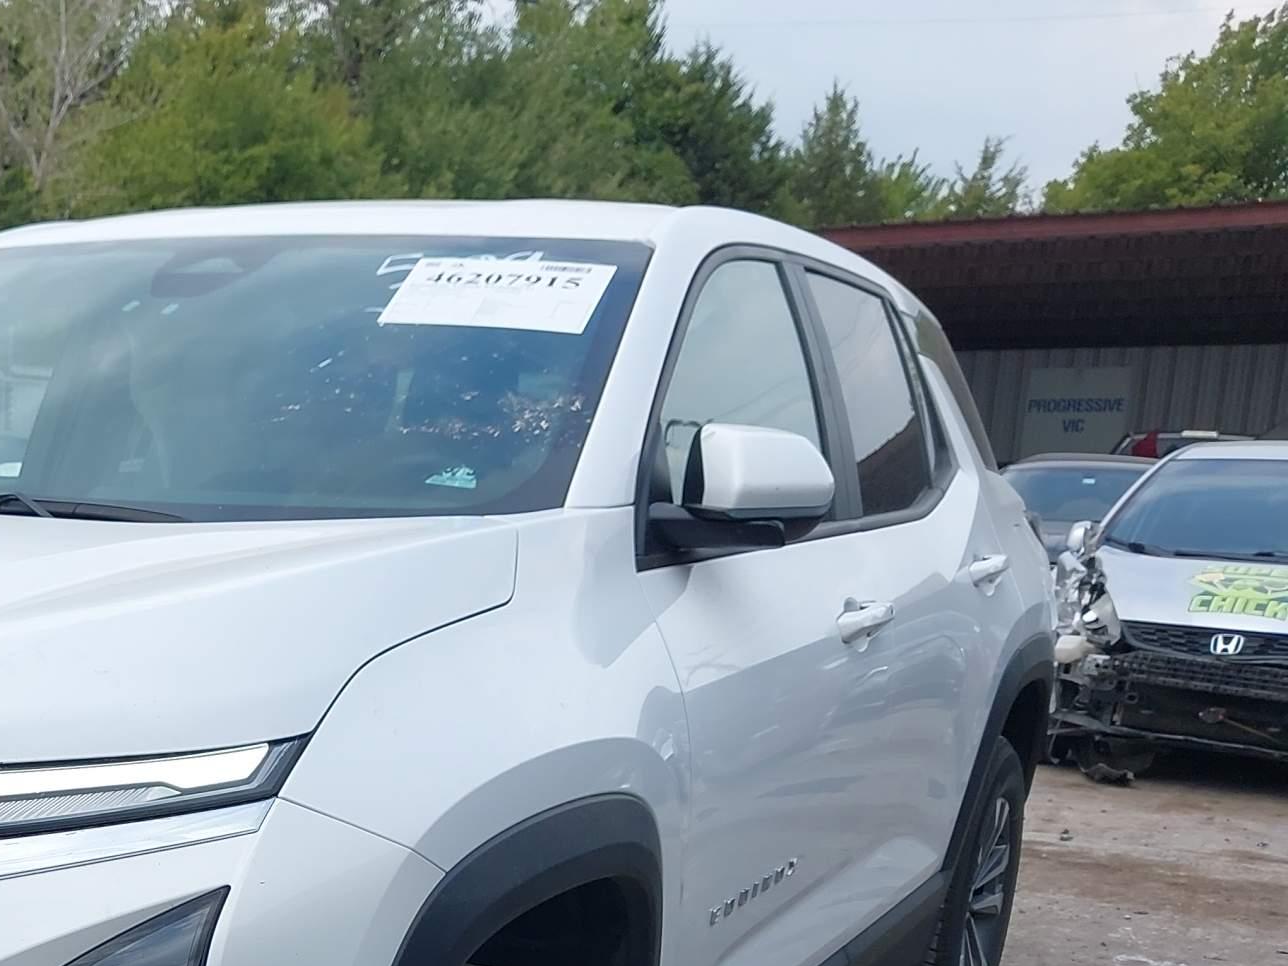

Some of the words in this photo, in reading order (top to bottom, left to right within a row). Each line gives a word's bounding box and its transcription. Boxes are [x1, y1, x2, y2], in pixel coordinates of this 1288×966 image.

[426, 272, 583, 290] 46207915
[1028, 398, 1124, 413] PROGRESSIVE
[1063, 418, 1085, 433] VIC
